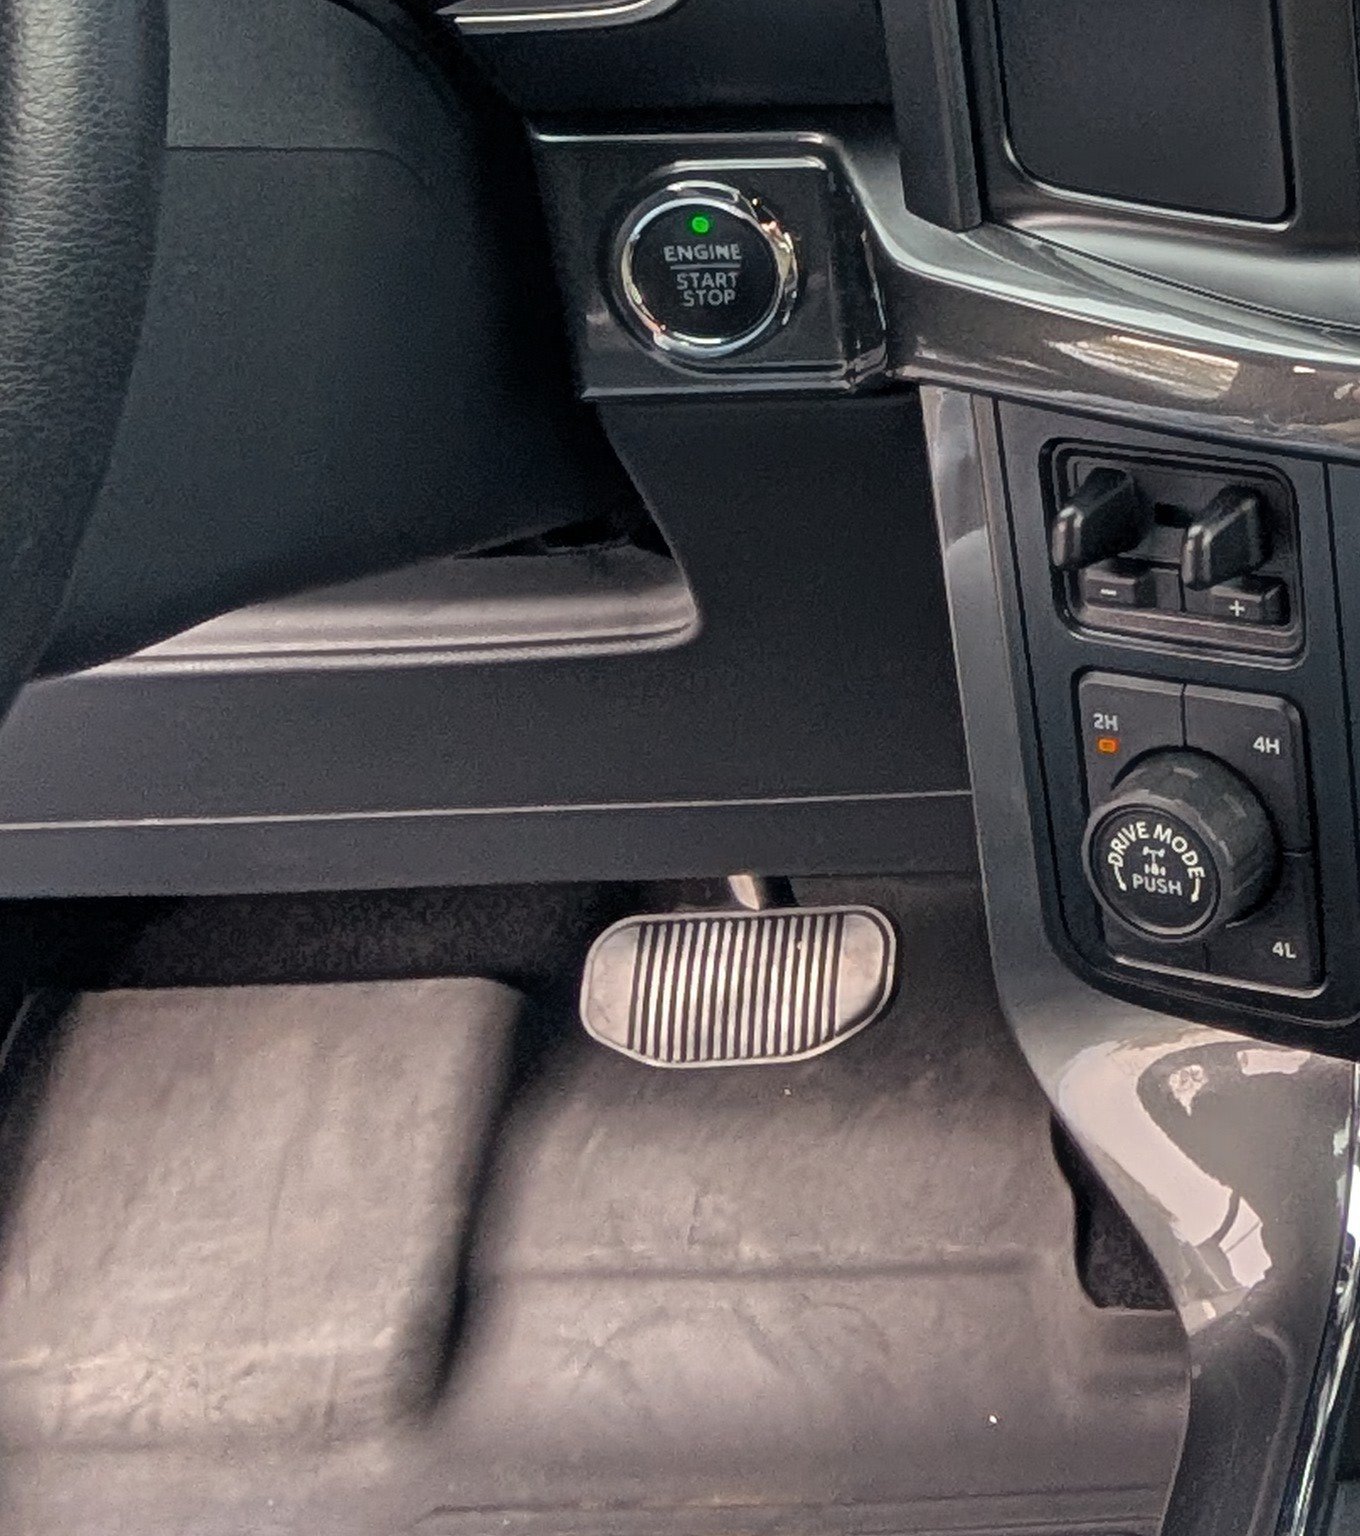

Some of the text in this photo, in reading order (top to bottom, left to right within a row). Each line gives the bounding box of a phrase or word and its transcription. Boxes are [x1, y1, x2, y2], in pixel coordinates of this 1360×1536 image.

[664, 244, 741, 261] ENGINE
[676, 271, 738, 289] START
[683, 289, 736, 307] STOP
[1094, 713, 1118, 731] 2H
[1253, 736, 1280, 754] 4H
[1107, 821, 1205, 878] DRIVE MODE
[1132, 873, 1182, 896] PUSH
[1272, 942, 1297, 959] 4L
